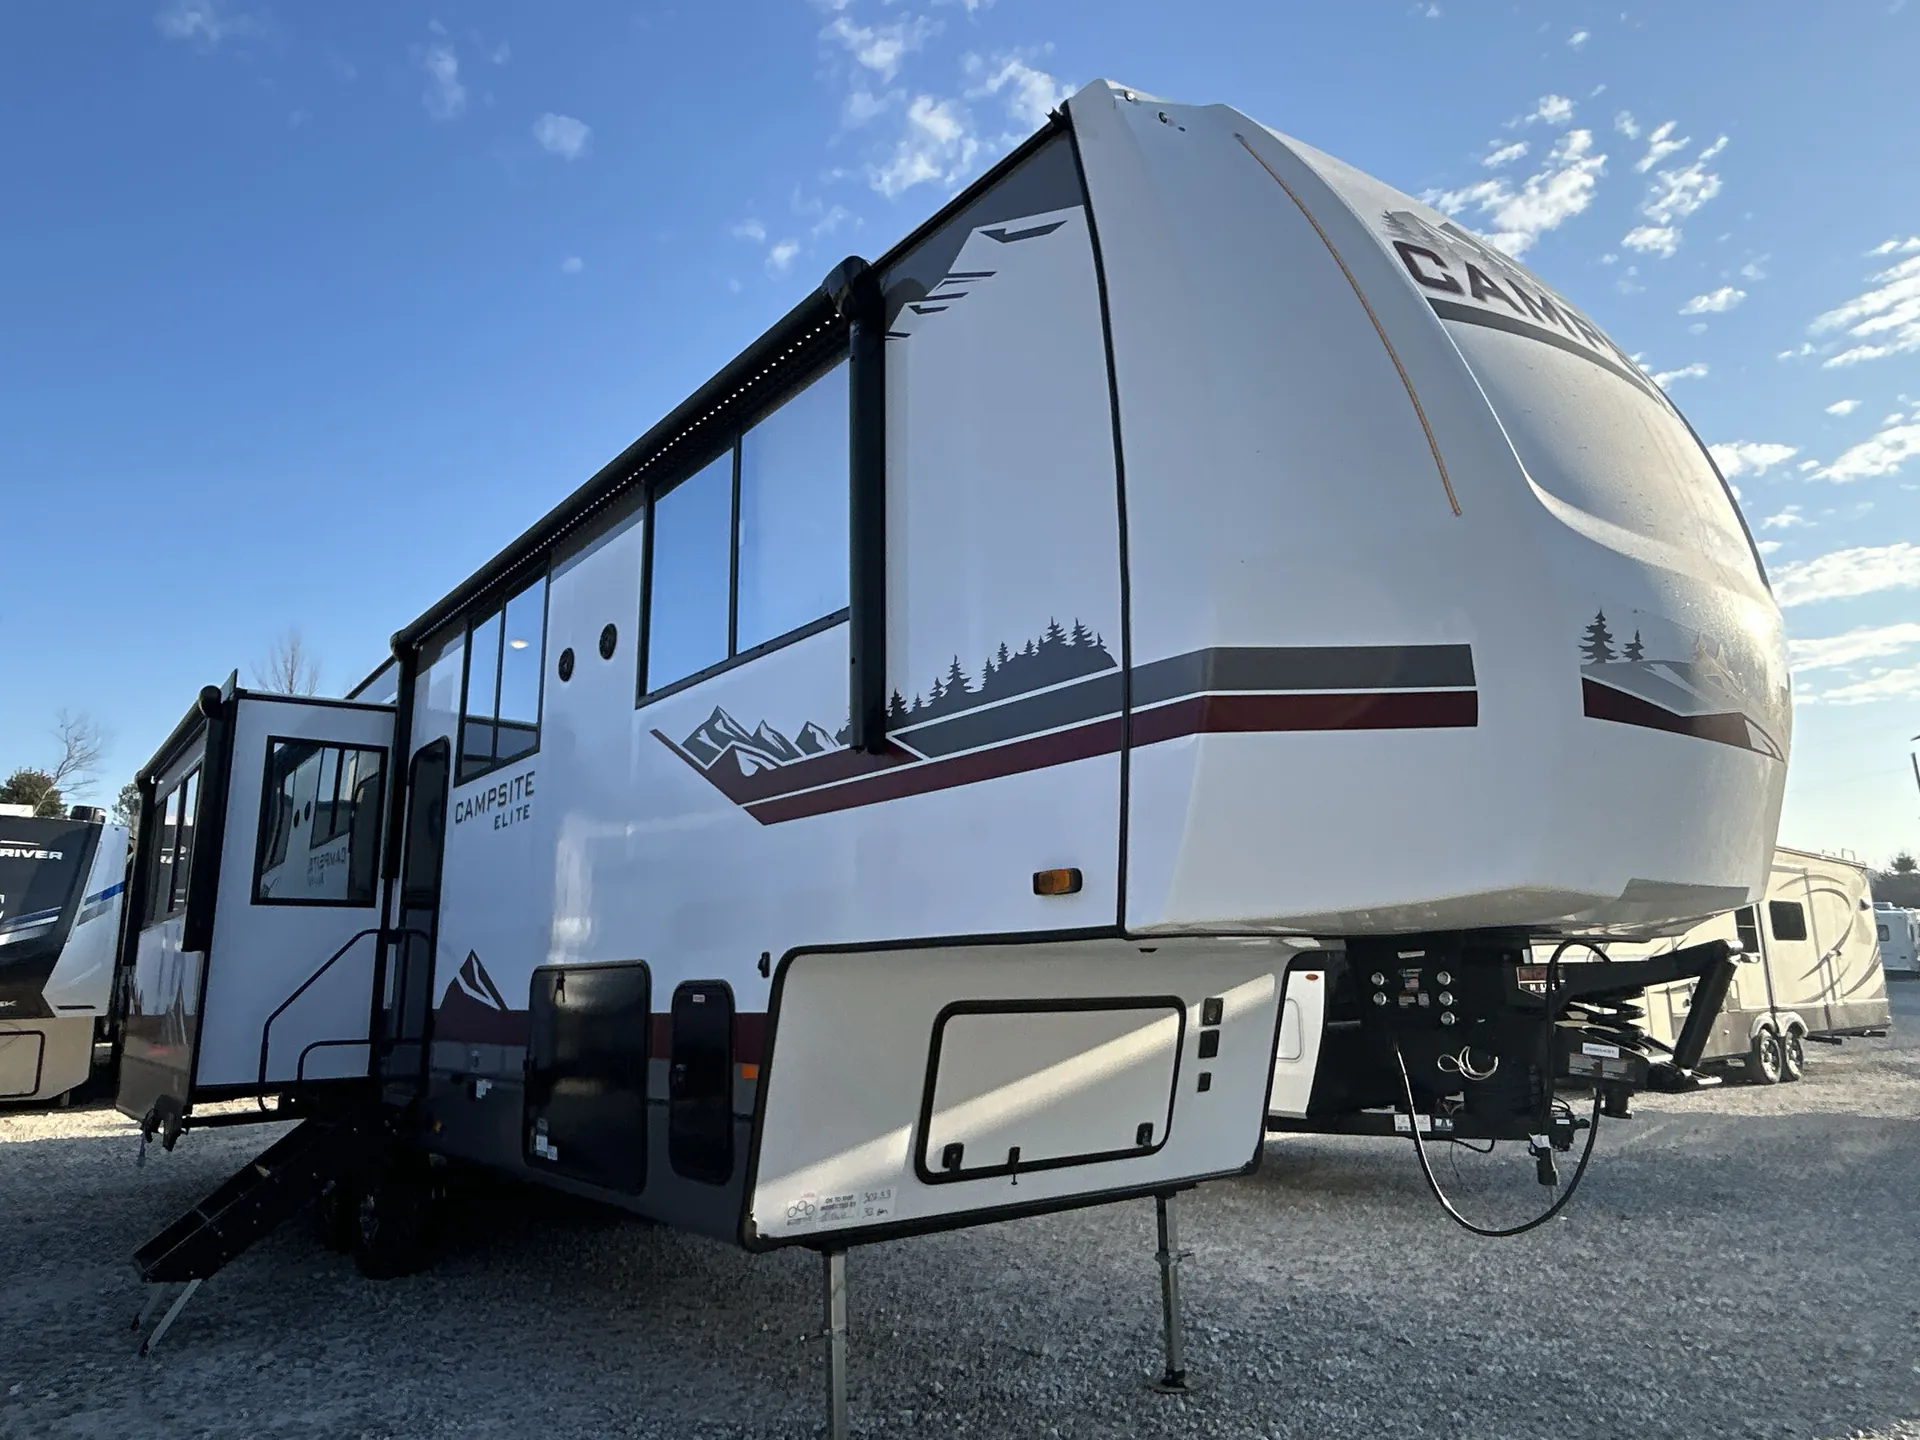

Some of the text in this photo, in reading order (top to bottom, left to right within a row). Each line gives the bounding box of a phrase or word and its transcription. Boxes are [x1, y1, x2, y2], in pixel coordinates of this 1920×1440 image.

[455, 770, 535, 824] CAMPSITE
[494, 804, 531, 831] ELITE
[0, 848, 63, 860] RIVER
